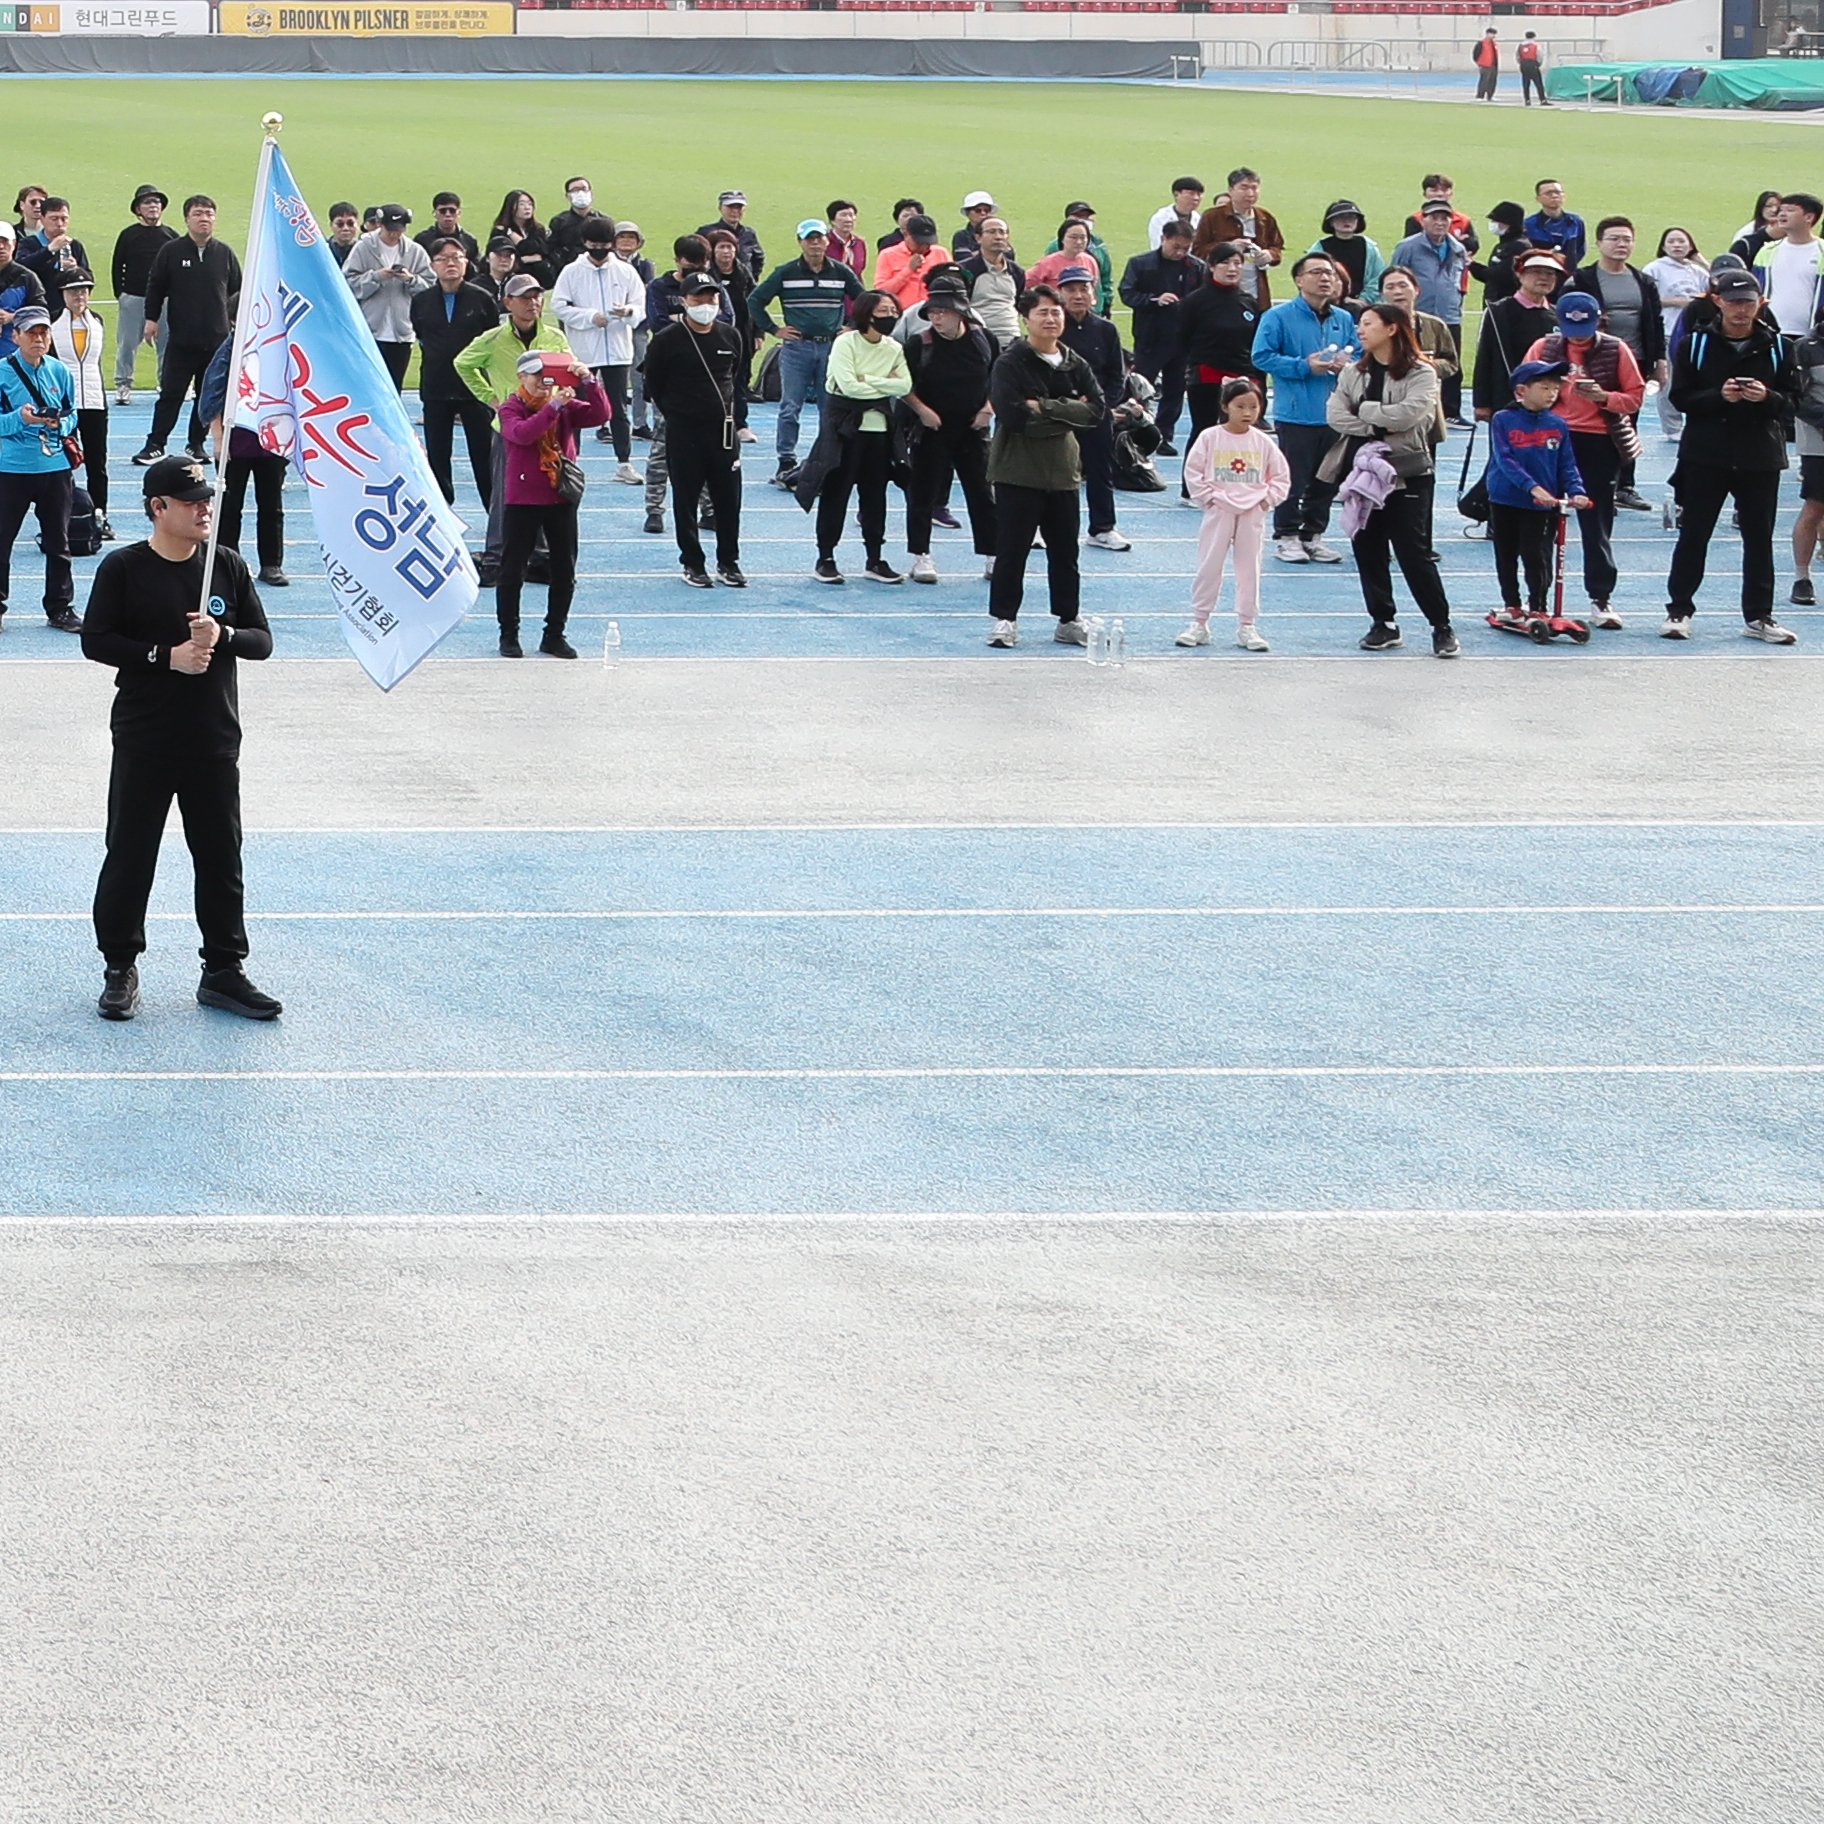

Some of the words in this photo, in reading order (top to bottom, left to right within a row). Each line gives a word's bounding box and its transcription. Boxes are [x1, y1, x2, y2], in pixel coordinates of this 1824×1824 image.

[75, 9, 178, 28] 현대그린푸드
[279, 9, 350, 30] BROOKLYN
[354, 9, 409, 30] PILSNER
[354, 475, 464, 600] 성남
